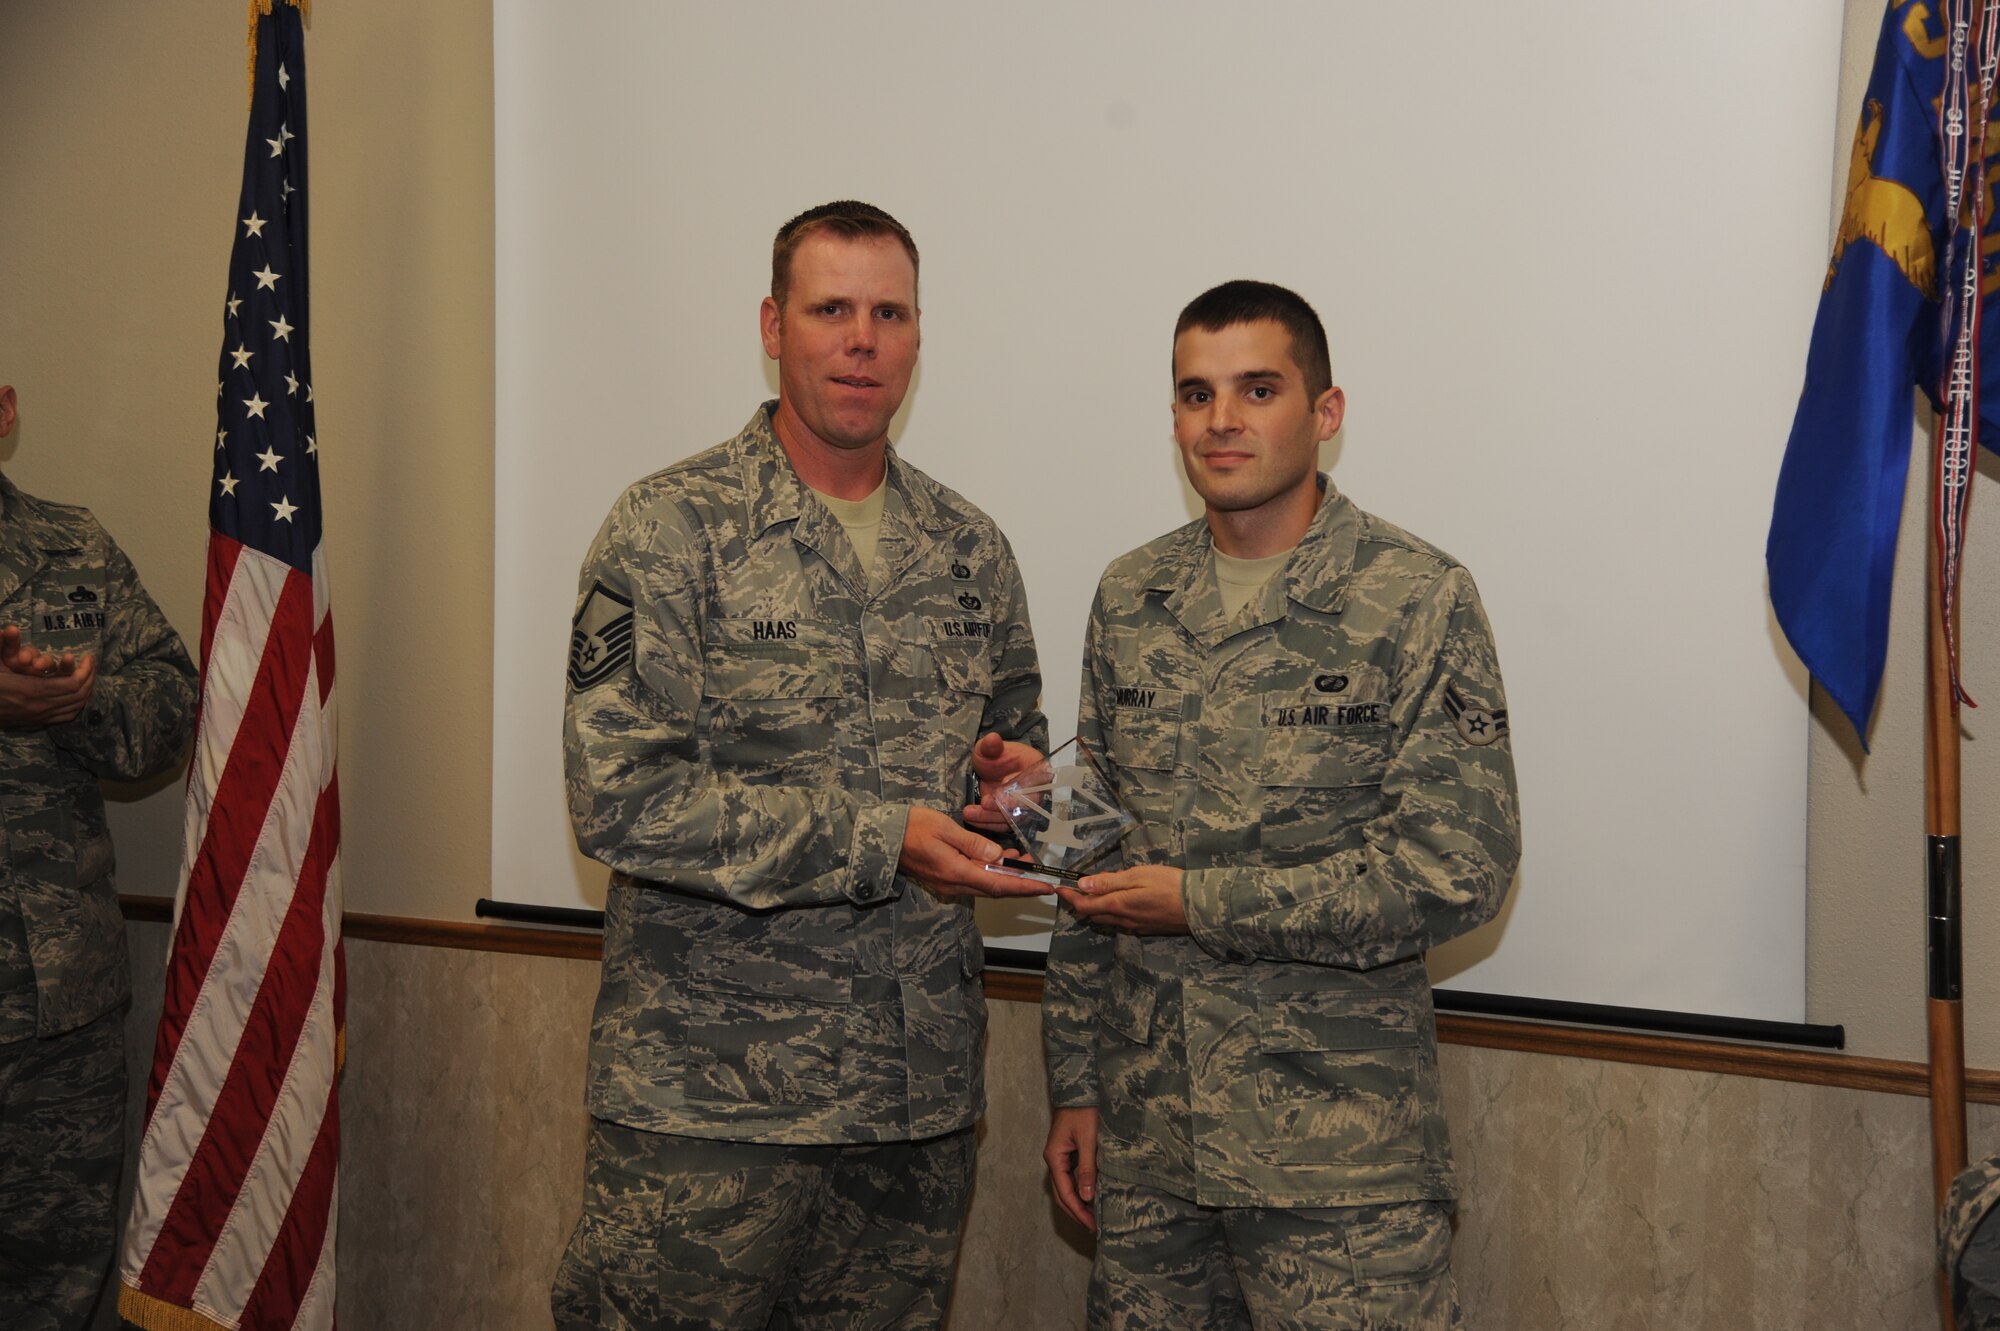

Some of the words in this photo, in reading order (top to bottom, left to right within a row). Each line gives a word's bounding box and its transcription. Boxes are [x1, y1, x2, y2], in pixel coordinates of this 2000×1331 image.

[1945, 107, 1964, 138] 30
[43, 614, 70, 630] U.S.
[753, 620, 797, 640] HAAS
[943, 620, 963, 637] U.S.
[1278, 708, 1297, 726] U.S.
[1302, 705, 1329, 725] AIR
[1337, 704, 1380, 725] FORCE
